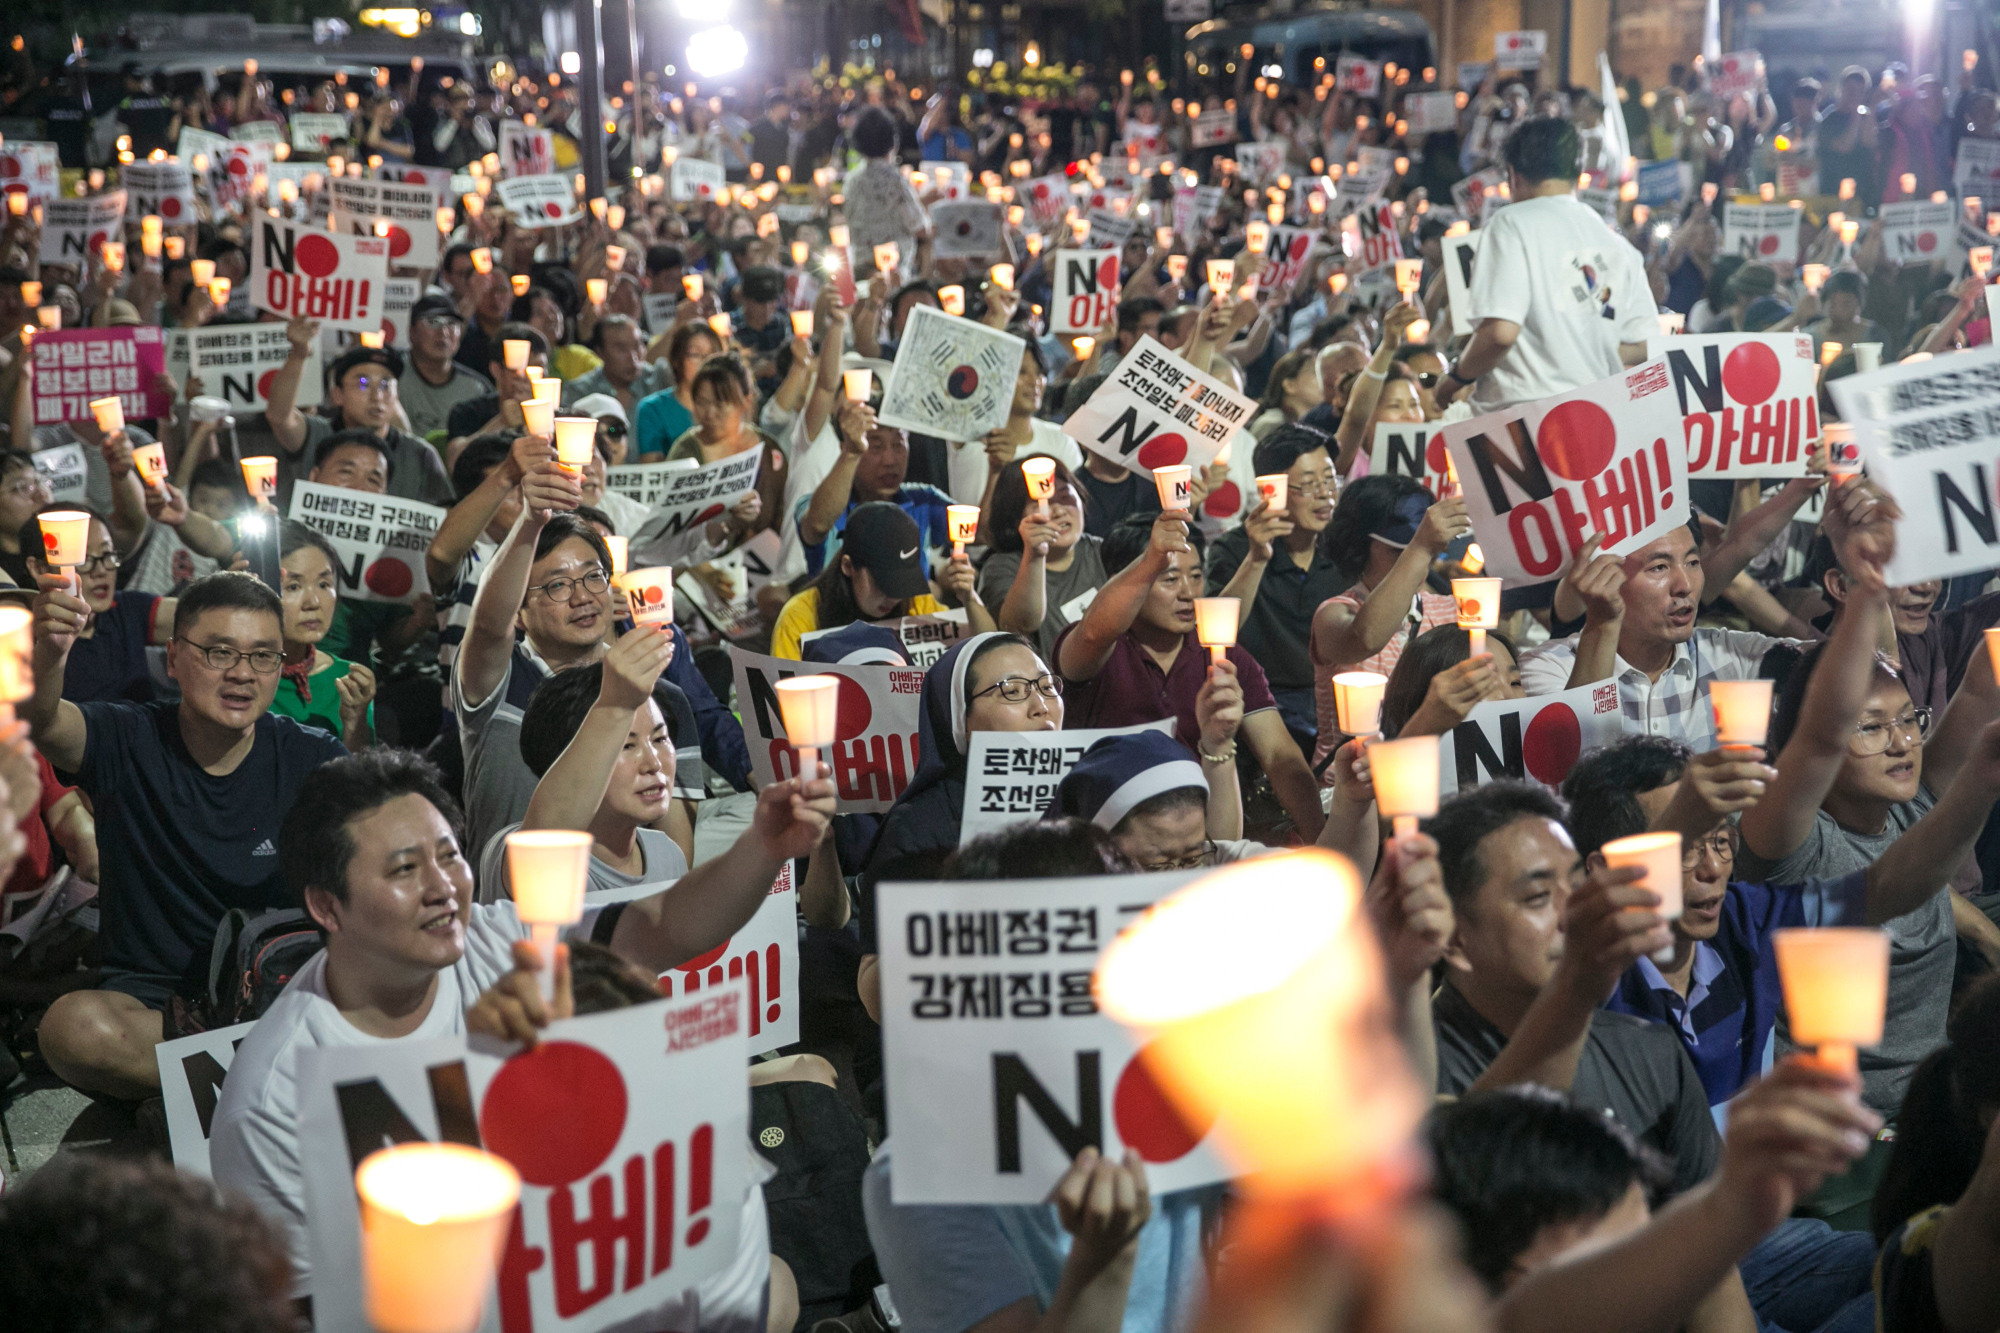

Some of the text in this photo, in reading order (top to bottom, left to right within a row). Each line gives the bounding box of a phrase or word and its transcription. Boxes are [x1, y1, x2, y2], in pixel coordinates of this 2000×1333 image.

[267, 270, 370, 320] 아베!
[1118, 368, 1180, 414] 조선일보
[1134, 349, 1195, 392] 토착왜구
[302, 492, 375, 520] 아베정권
[1508, 438, 1673, 576] 아베!
[903, 621, 959, 646] 탄한다
[889, 671, 926, 683] 아베규
[980, 785, 1056, 813] 조선일
[906, 907, 1100, 957] 아베정권
[908, 969, 1101, 1019] 강제징용
